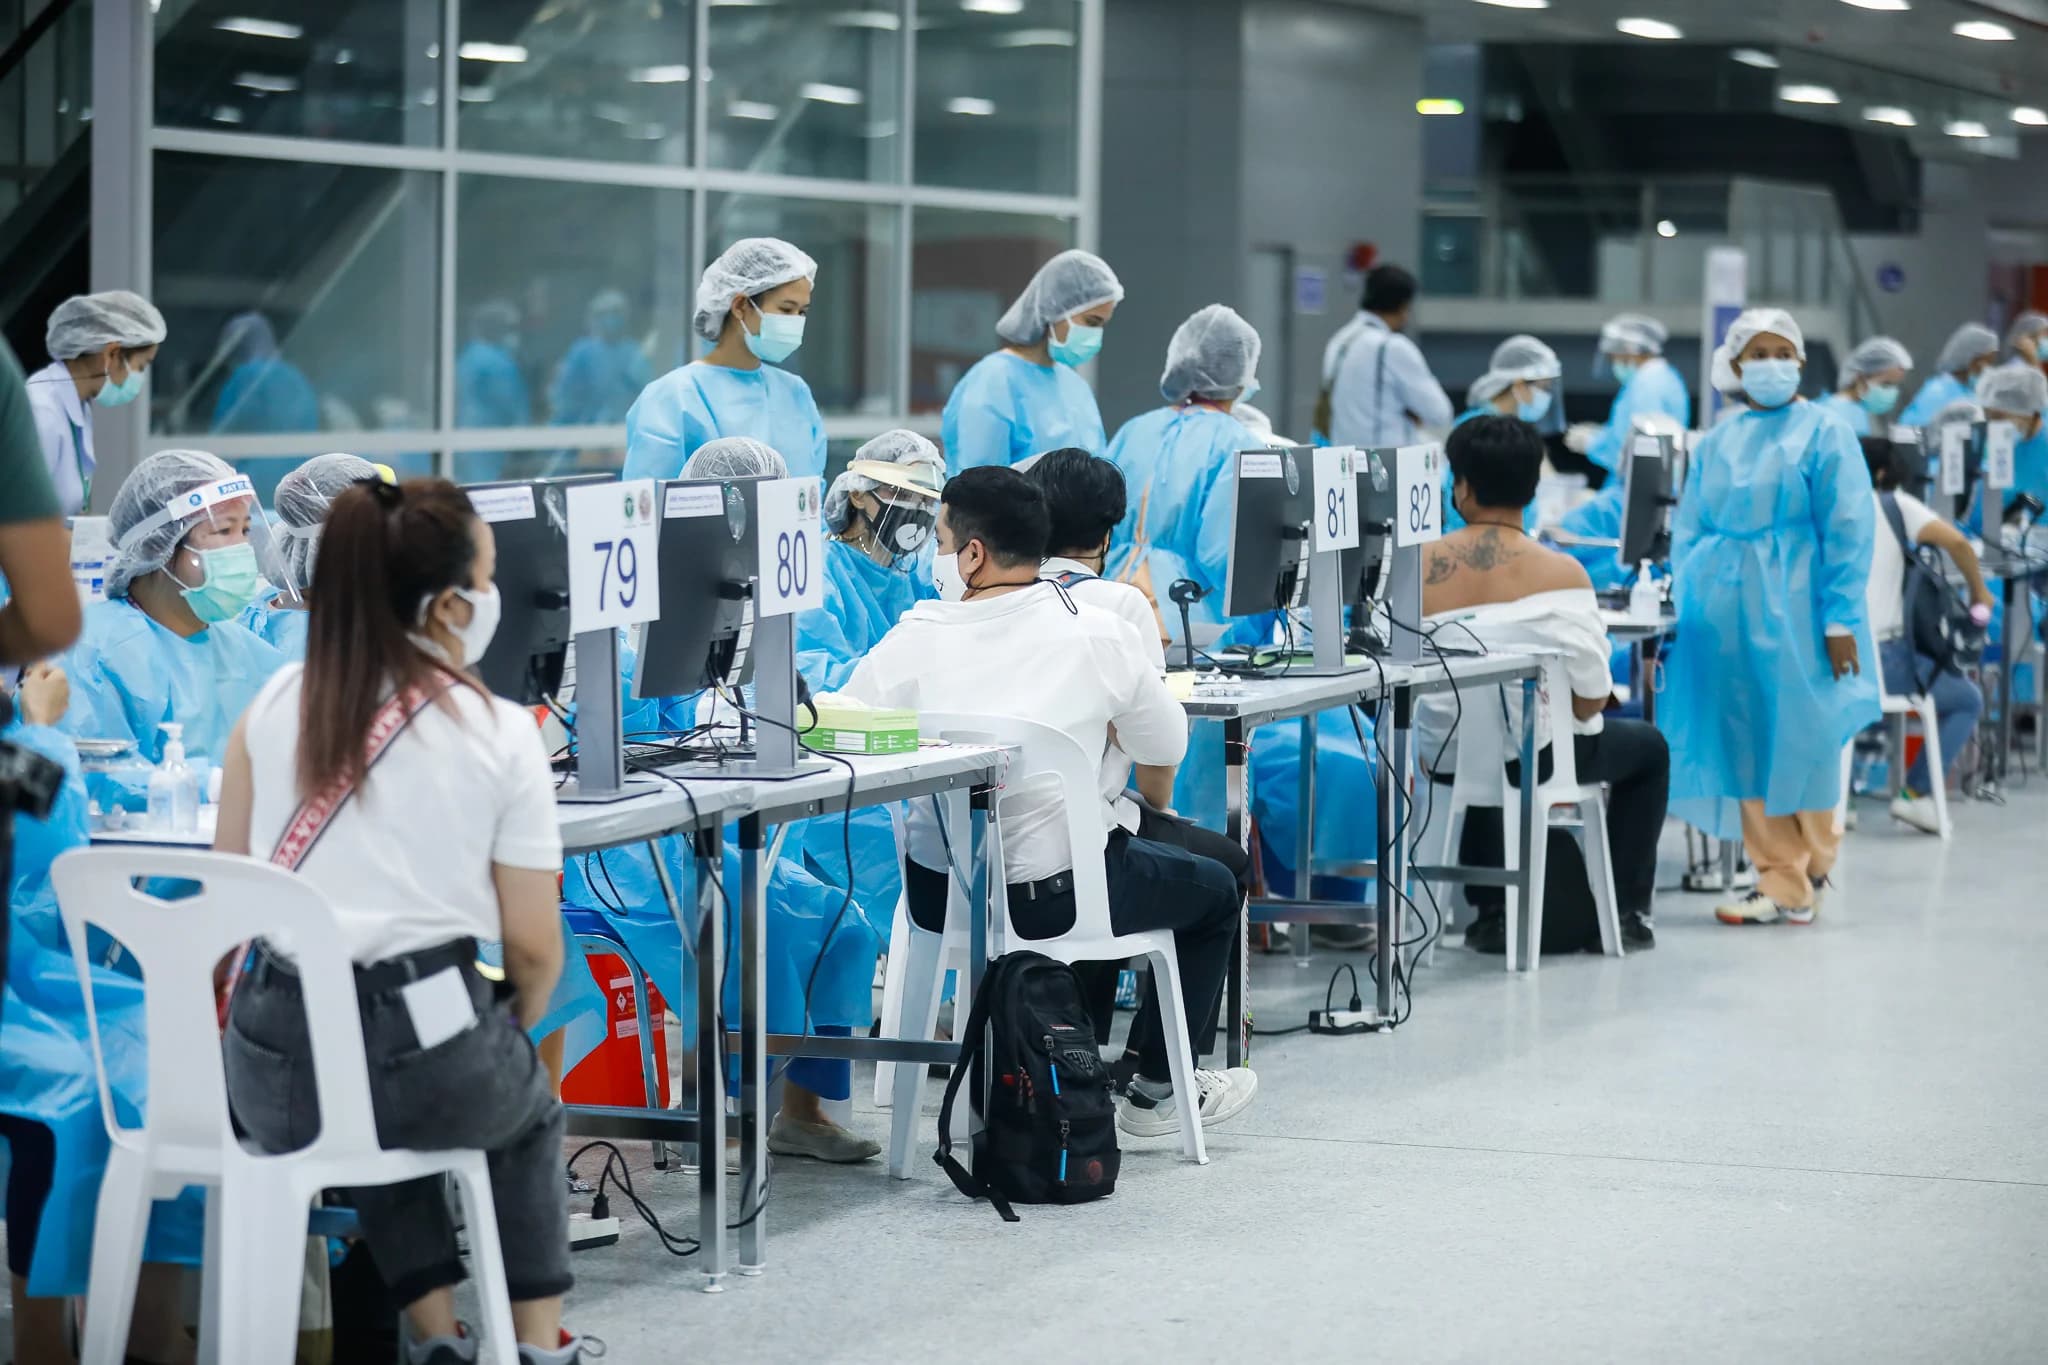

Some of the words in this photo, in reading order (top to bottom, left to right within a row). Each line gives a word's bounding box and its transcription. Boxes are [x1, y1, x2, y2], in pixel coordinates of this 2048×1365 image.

[1328, 487, 1347, 539] 81
[1410, 483, 1431, 533] 82
[594, 537, 638, 612] 79
[777, 529, 808, 599] 80
